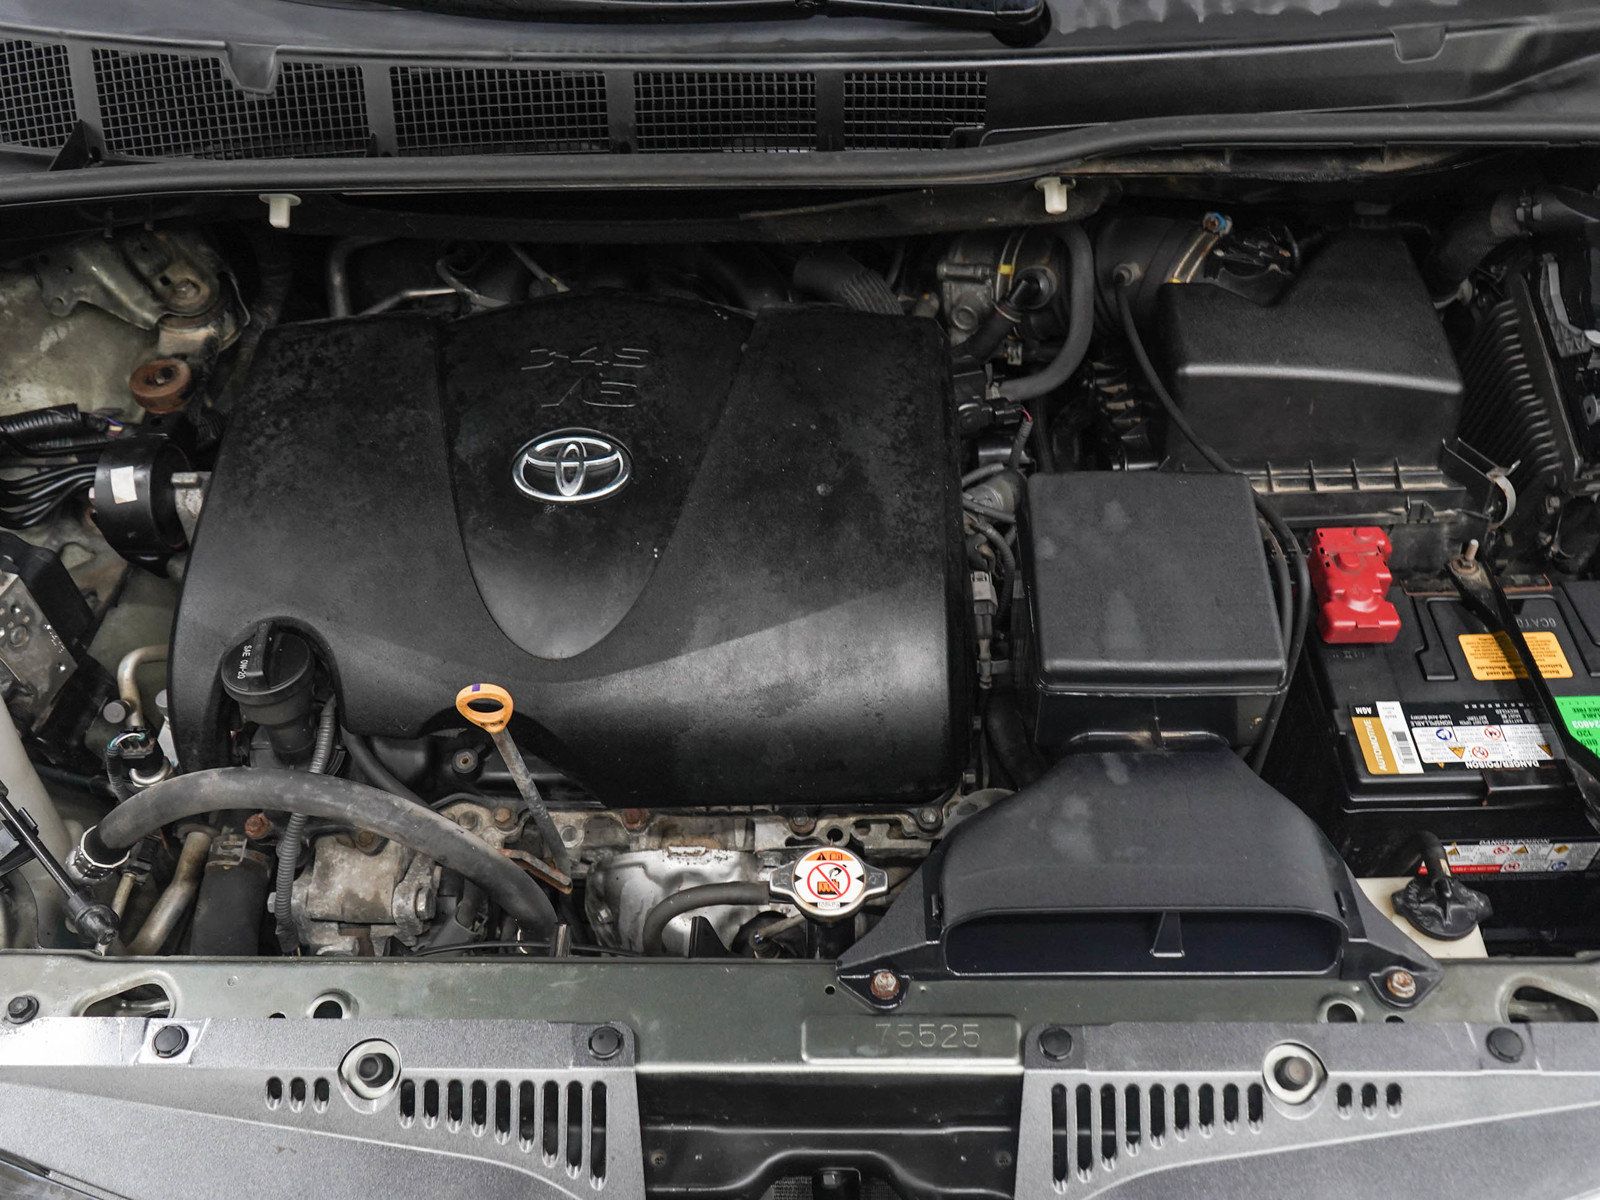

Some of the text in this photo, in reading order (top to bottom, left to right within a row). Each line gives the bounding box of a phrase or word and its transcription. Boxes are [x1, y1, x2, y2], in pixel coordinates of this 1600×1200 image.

[237, 644, 253, 680] SAE 0W-20
[1363, 719, 1388, 772] AUTOMOTIVE
[1465, 760, 1540, 769] DANGER/POISON
[875, 1022, 981, 1049] 75525
